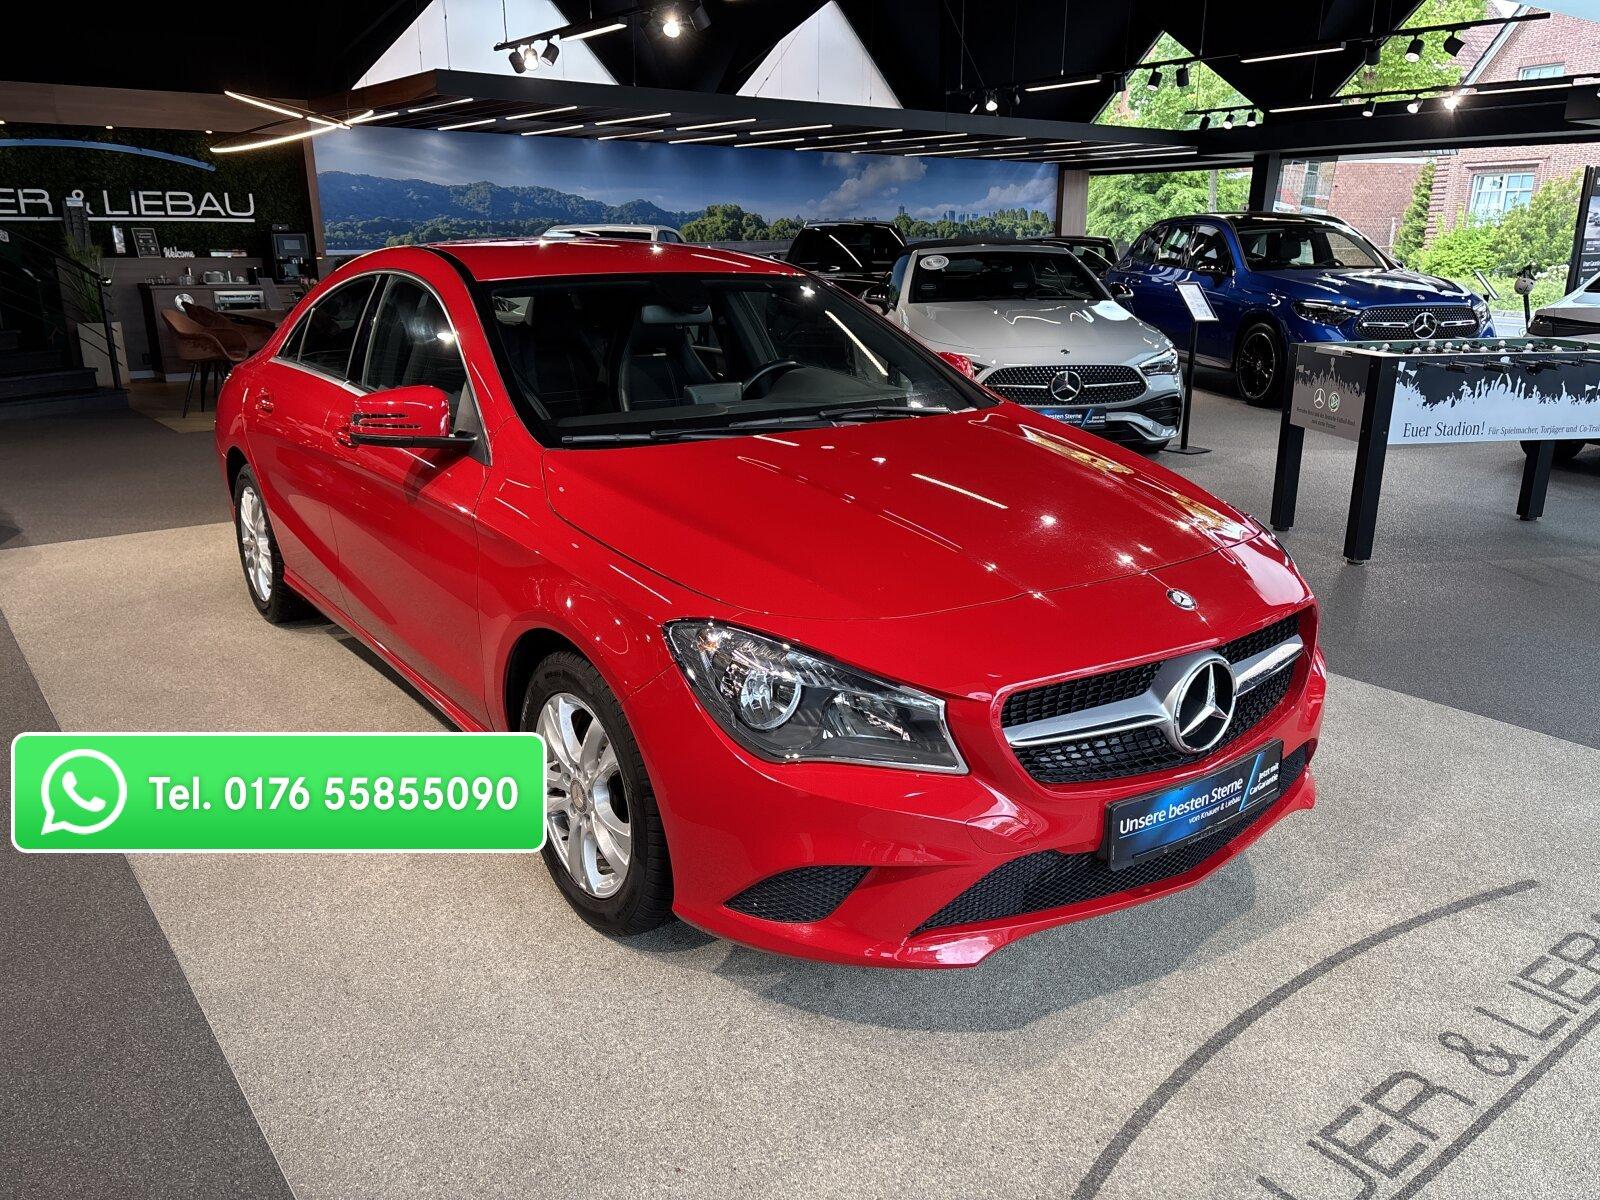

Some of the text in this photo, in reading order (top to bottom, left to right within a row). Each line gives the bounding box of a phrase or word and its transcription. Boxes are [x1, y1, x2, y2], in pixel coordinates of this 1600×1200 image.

[163, 246, 195, 258] Welcome
[1402, 422, 1432, 438] Euer
[1434, 421, 1486, 437] Stadion!
[1488, 426, 1500, 436] Für
[1500, 426, 1539, 436] Spielmacher,
[1541, 425, 1565, 436] Torjäger
[1565, 424, 1578, 433] und
[1119, 777, 1244, 834] Unsere besten Sterne
[1188, 814, 1201, 824] von
[1200, 805, 1221, 820] Knauer
[1438, 1030, 1529, 1077] &
